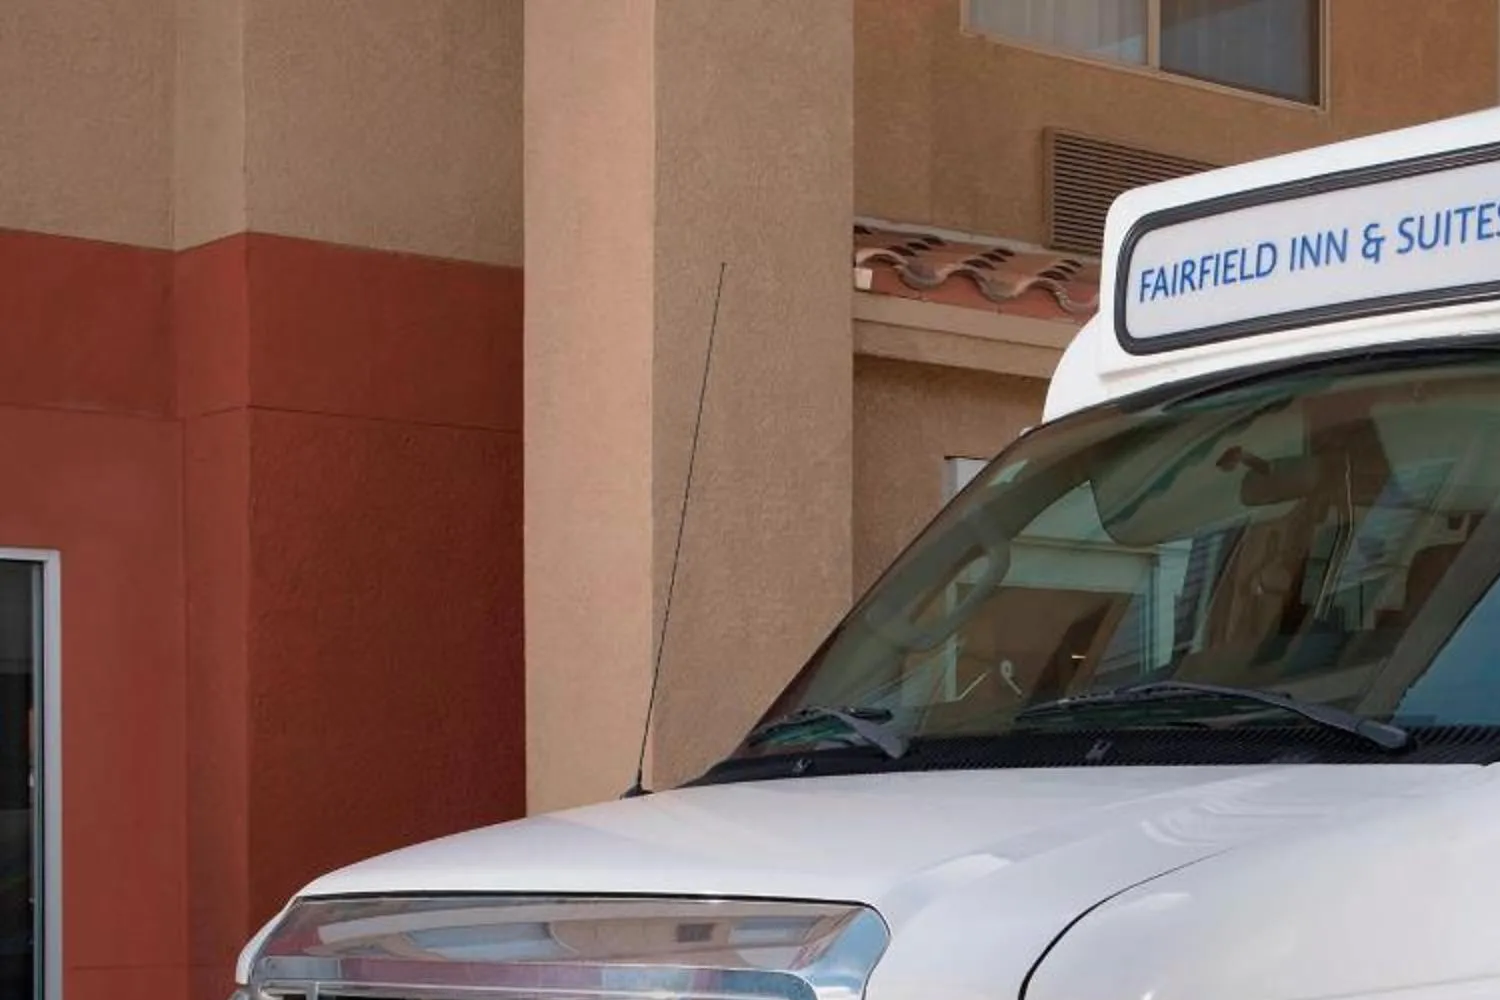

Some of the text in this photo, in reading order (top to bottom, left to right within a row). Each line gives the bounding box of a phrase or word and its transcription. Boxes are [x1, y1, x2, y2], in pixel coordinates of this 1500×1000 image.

[1138, 240, 1278, 303] FAIRFIELD
[1290, 227, 1349, 272] INN
[1361, 223, 1387, 264] &
